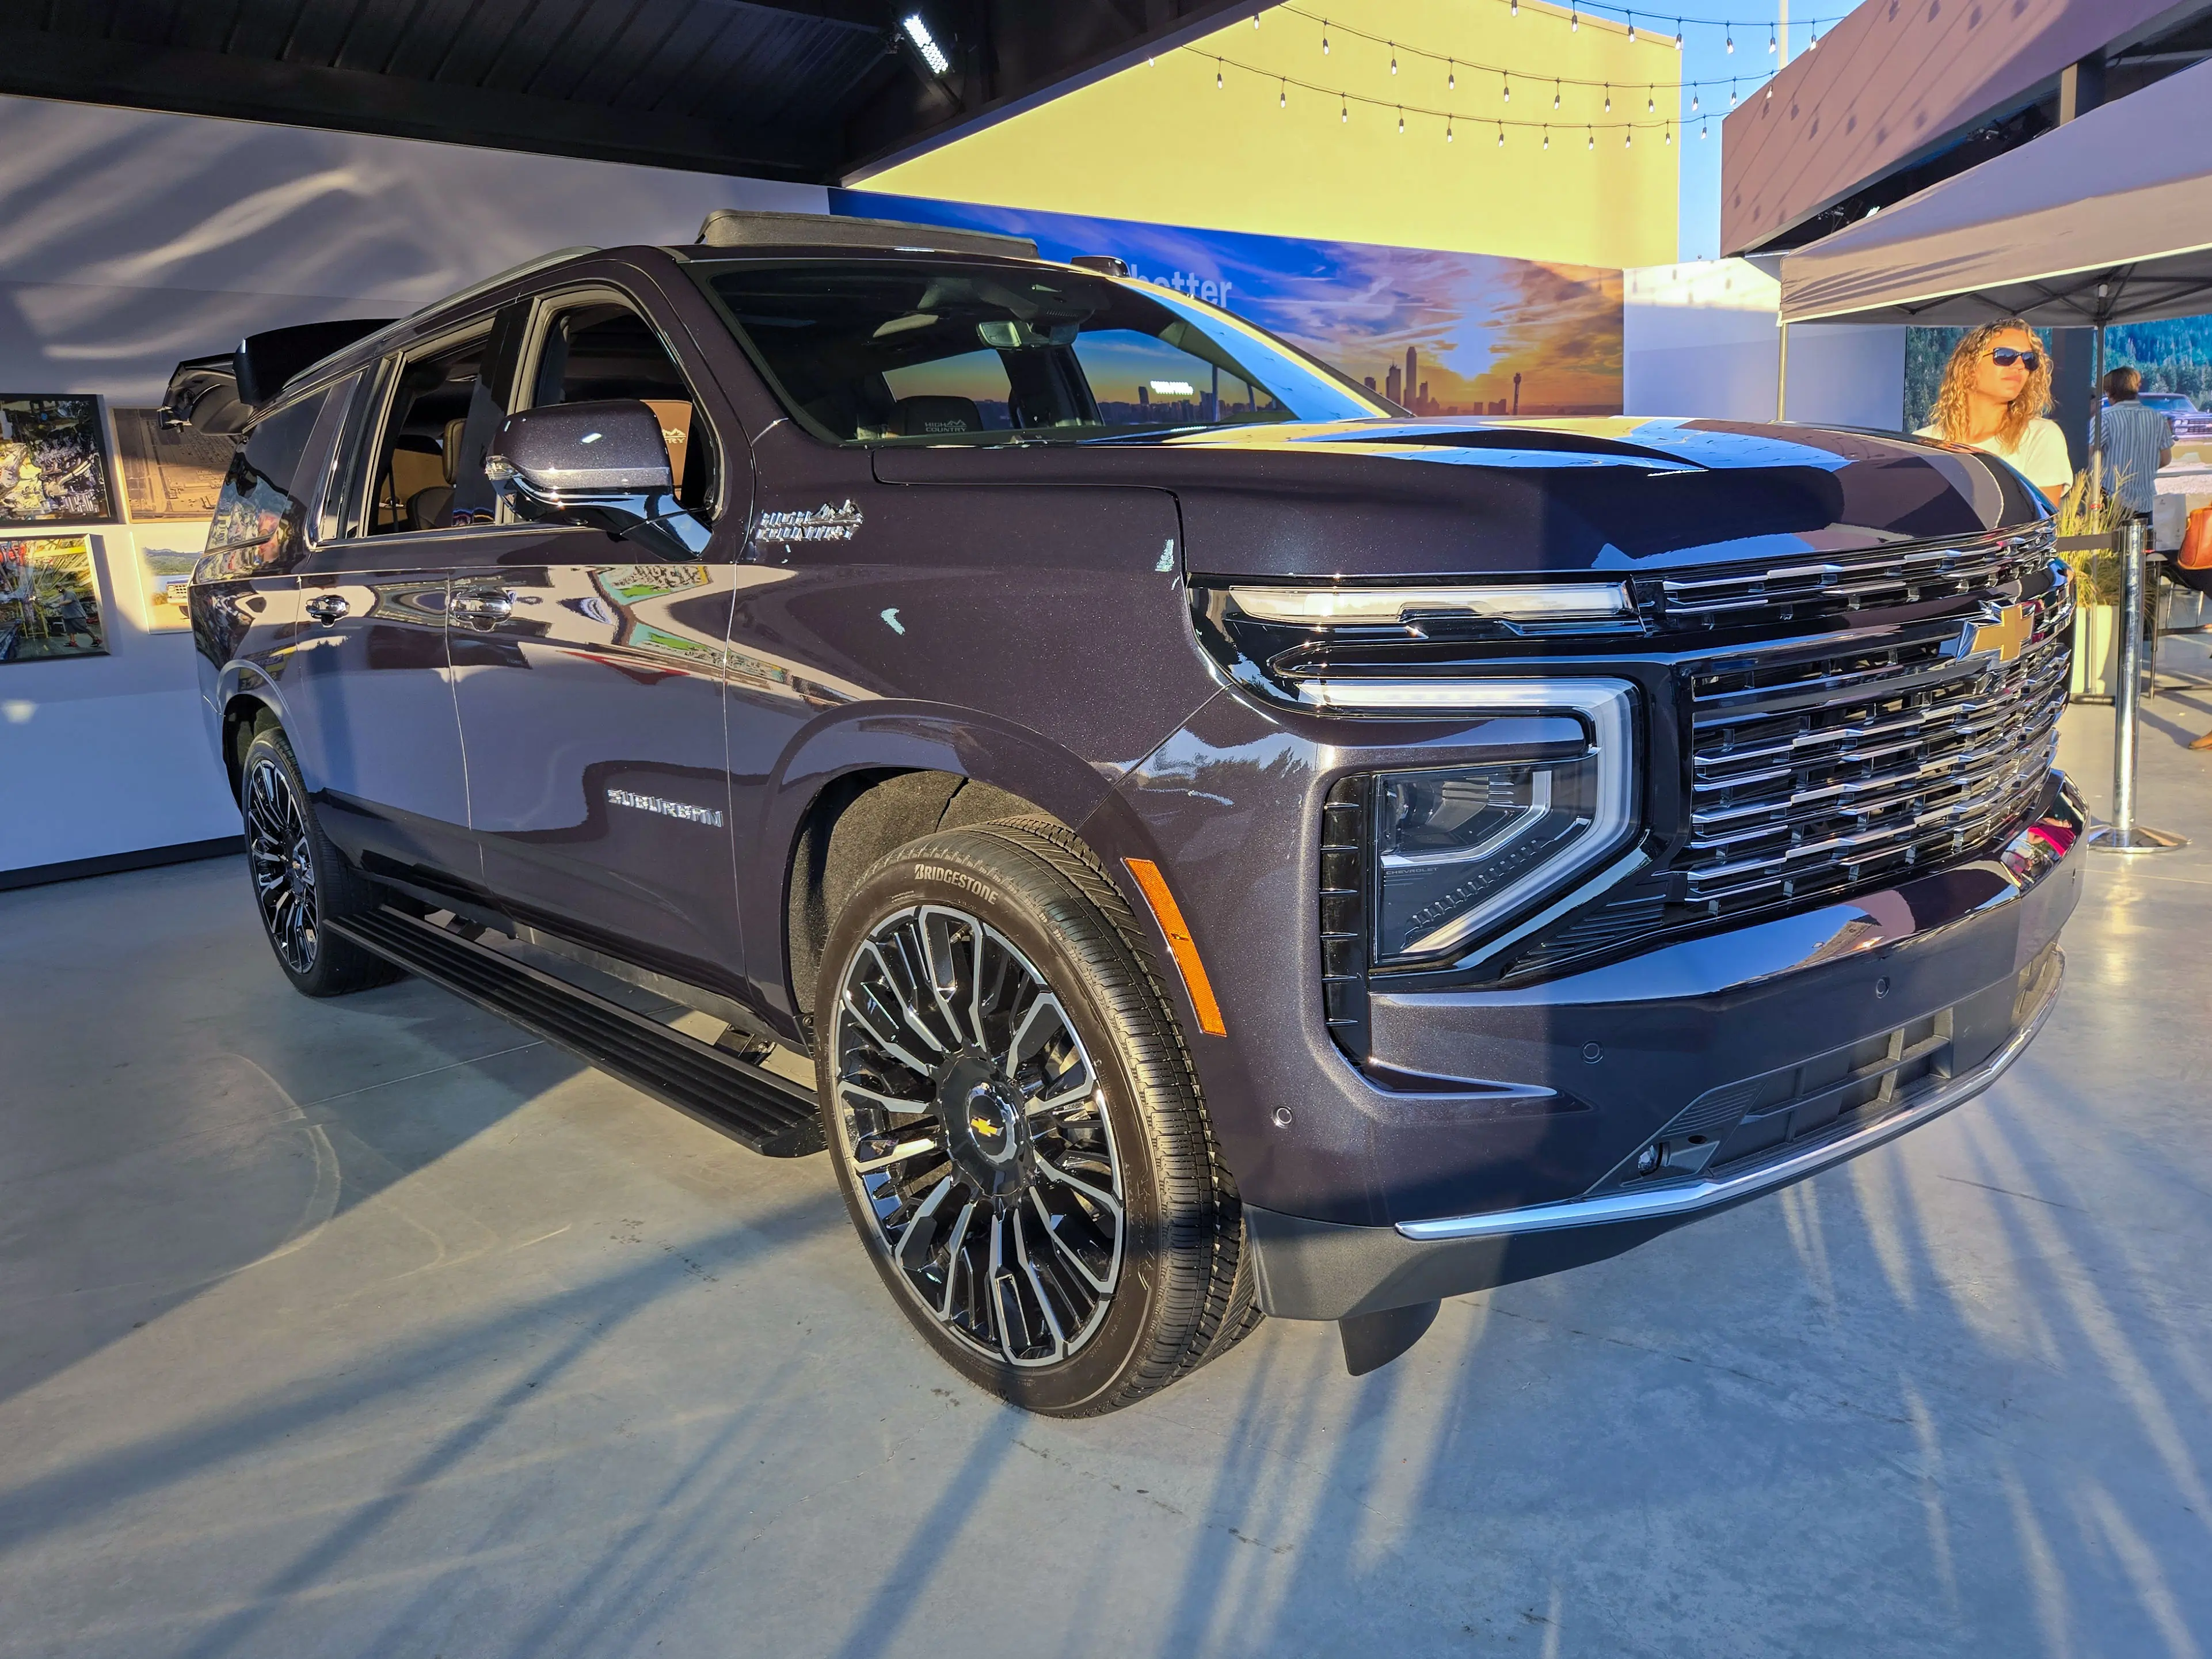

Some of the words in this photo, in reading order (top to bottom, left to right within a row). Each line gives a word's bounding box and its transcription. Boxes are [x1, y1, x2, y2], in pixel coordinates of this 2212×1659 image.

[1131, 264, 1232, 308] tter
[607, 788, 724, 828] SUBURBAN
[914, 863, 999, 905] BRIDGESTONE
[1385, 867, 1439, 875] CHEVROLET
